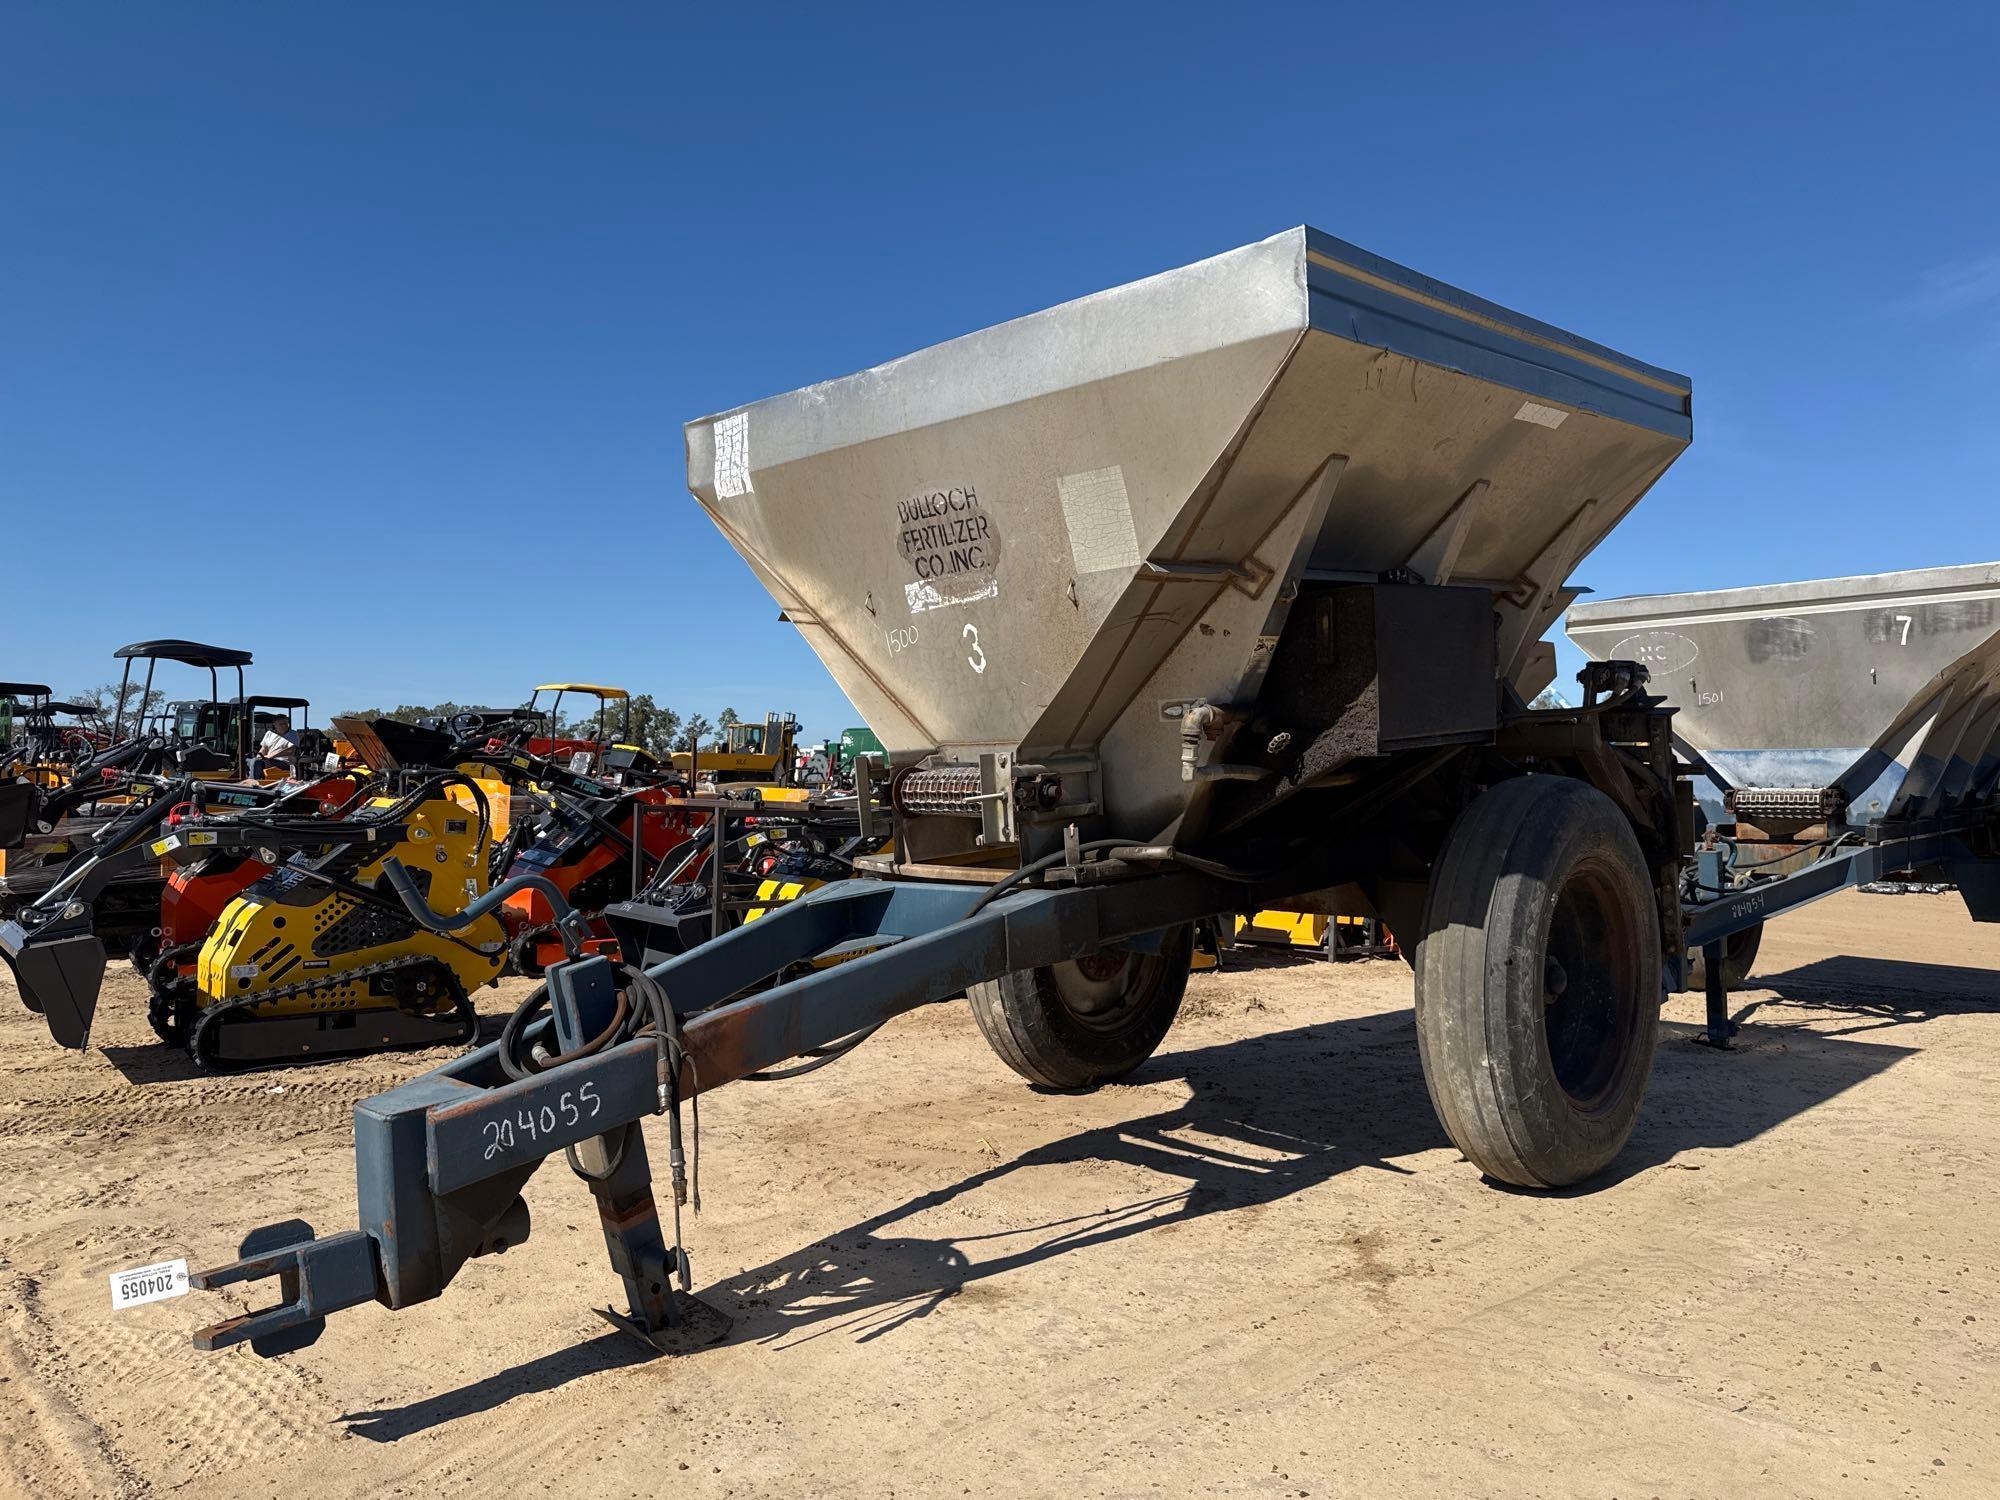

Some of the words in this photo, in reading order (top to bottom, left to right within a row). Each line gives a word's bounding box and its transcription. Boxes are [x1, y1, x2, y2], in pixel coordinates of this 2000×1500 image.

[897, 485, 979, 524] BULLOCH
[902, 515, 991, 553] FERTILIZER
[884, 625, 919, 657] 1500
[1896, 615, 1912, 646] 7
[962, 623, 987, 674] 3
[1697, 690, 1724, 706] 1501
[483, 1081, 601, 1160] 204055
[121, 1274, 173, 1300] 204055
